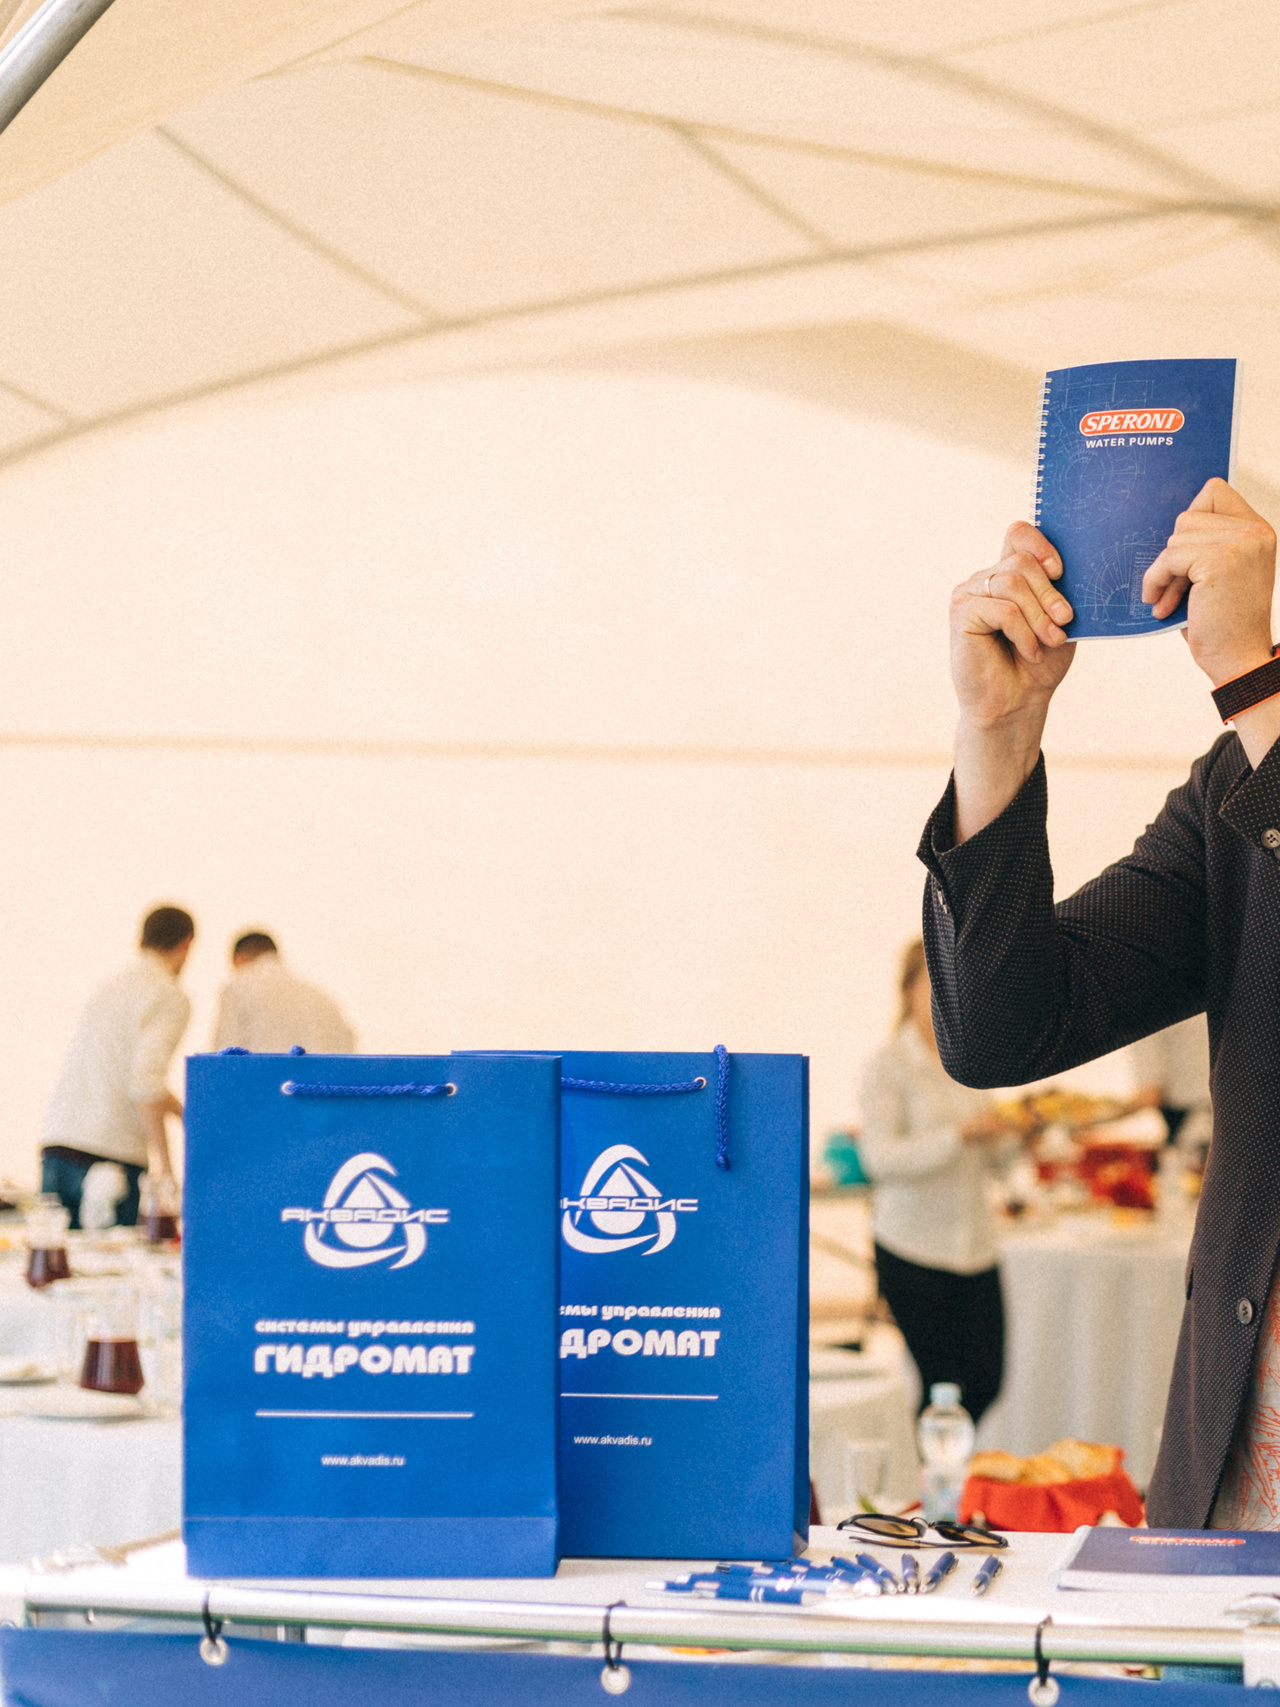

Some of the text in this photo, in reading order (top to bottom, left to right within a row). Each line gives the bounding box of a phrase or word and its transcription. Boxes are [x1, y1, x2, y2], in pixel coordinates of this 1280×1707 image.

[1083, 413, 1177, 432] SPERONI
[1085, 436, 1174, 449] WATER PUMPS
[560, 1197, 699, 1212] КВАДИС
[281, 1207, 450, 1223] АКВАДИС
[601, 1306, 721, 1321] управления
[254, 1319, 475, 1338] системы управления
[560, 1328, 721, 1359] ДРОМАТ
[254, 1344, 476, 1378] ГИДРОМАТ
[573, 1435, 652, 1446] www.akvadis.ru
[321, 1455, 405, 1467] www.akvadis.ru
